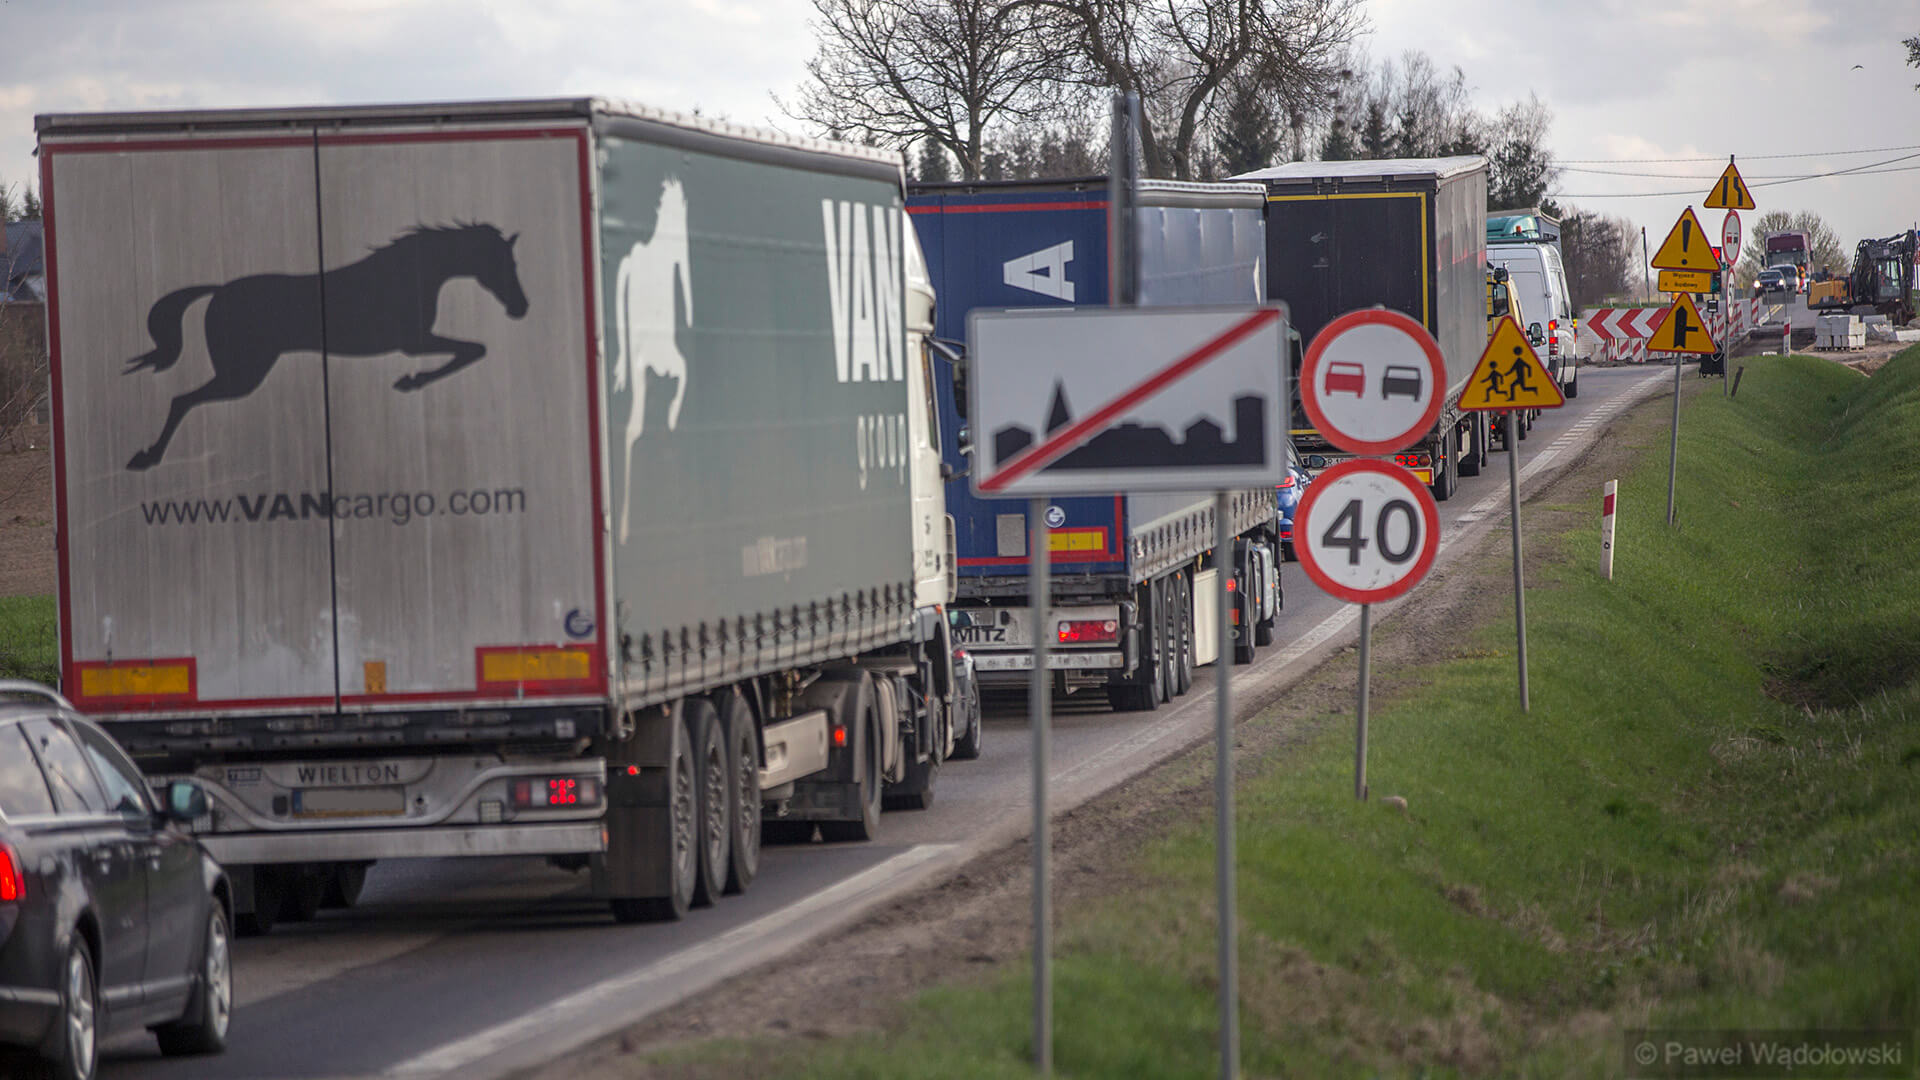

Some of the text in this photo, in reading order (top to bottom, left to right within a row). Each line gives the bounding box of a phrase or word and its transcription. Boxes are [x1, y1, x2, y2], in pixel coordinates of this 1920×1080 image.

[821, 199, 904, 383] VAN
[856, 413, 907, 492] group
[141, 487, 527, 527] www.VANcargo.com
[1321, 498, 1421, 566] 40
[298, 765, 399, 783] WIELTON
